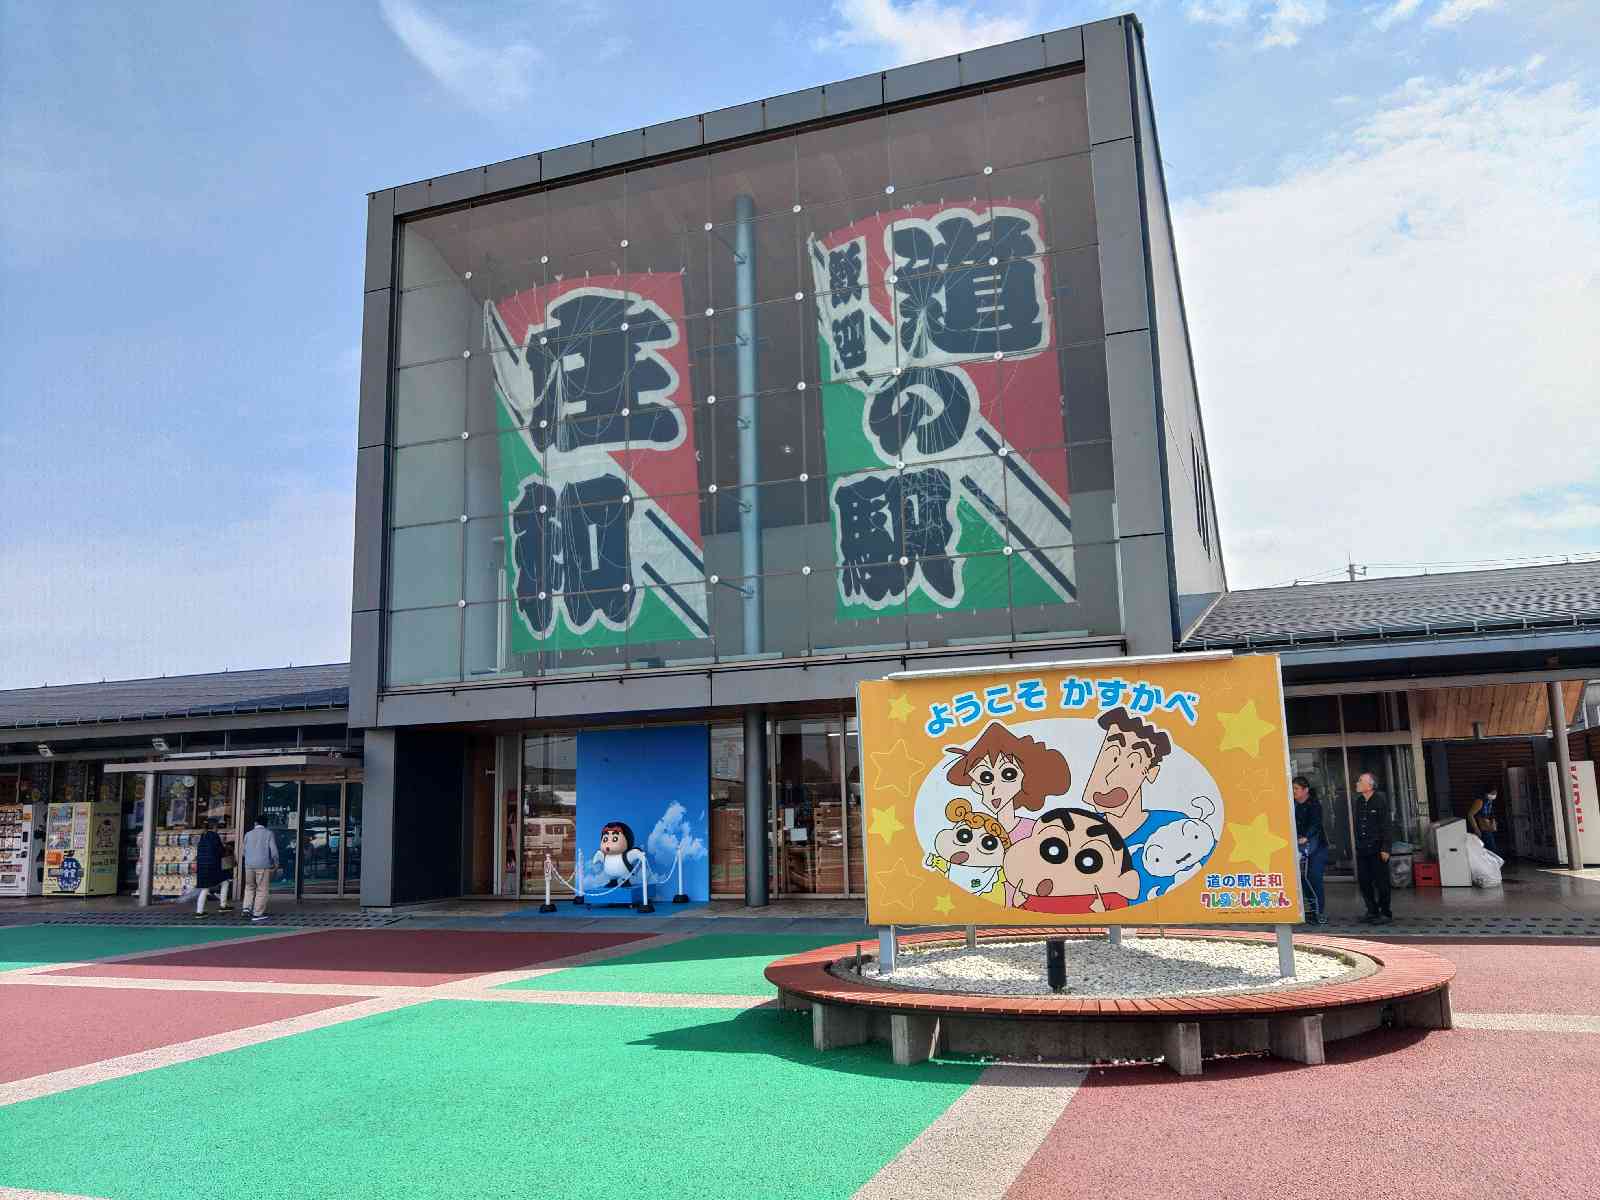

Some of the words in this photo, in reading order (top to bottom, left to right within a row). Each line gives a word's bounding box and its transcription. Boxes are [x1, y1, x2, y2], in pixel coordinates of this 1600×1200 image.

[514, 294, 680, 634] 庄和
[927, 680, 1047, 735] ようこそ
[1062, 677, 1198, 722] かすかべ
[1207, 874, 1282, 888] 道の駅庄和
